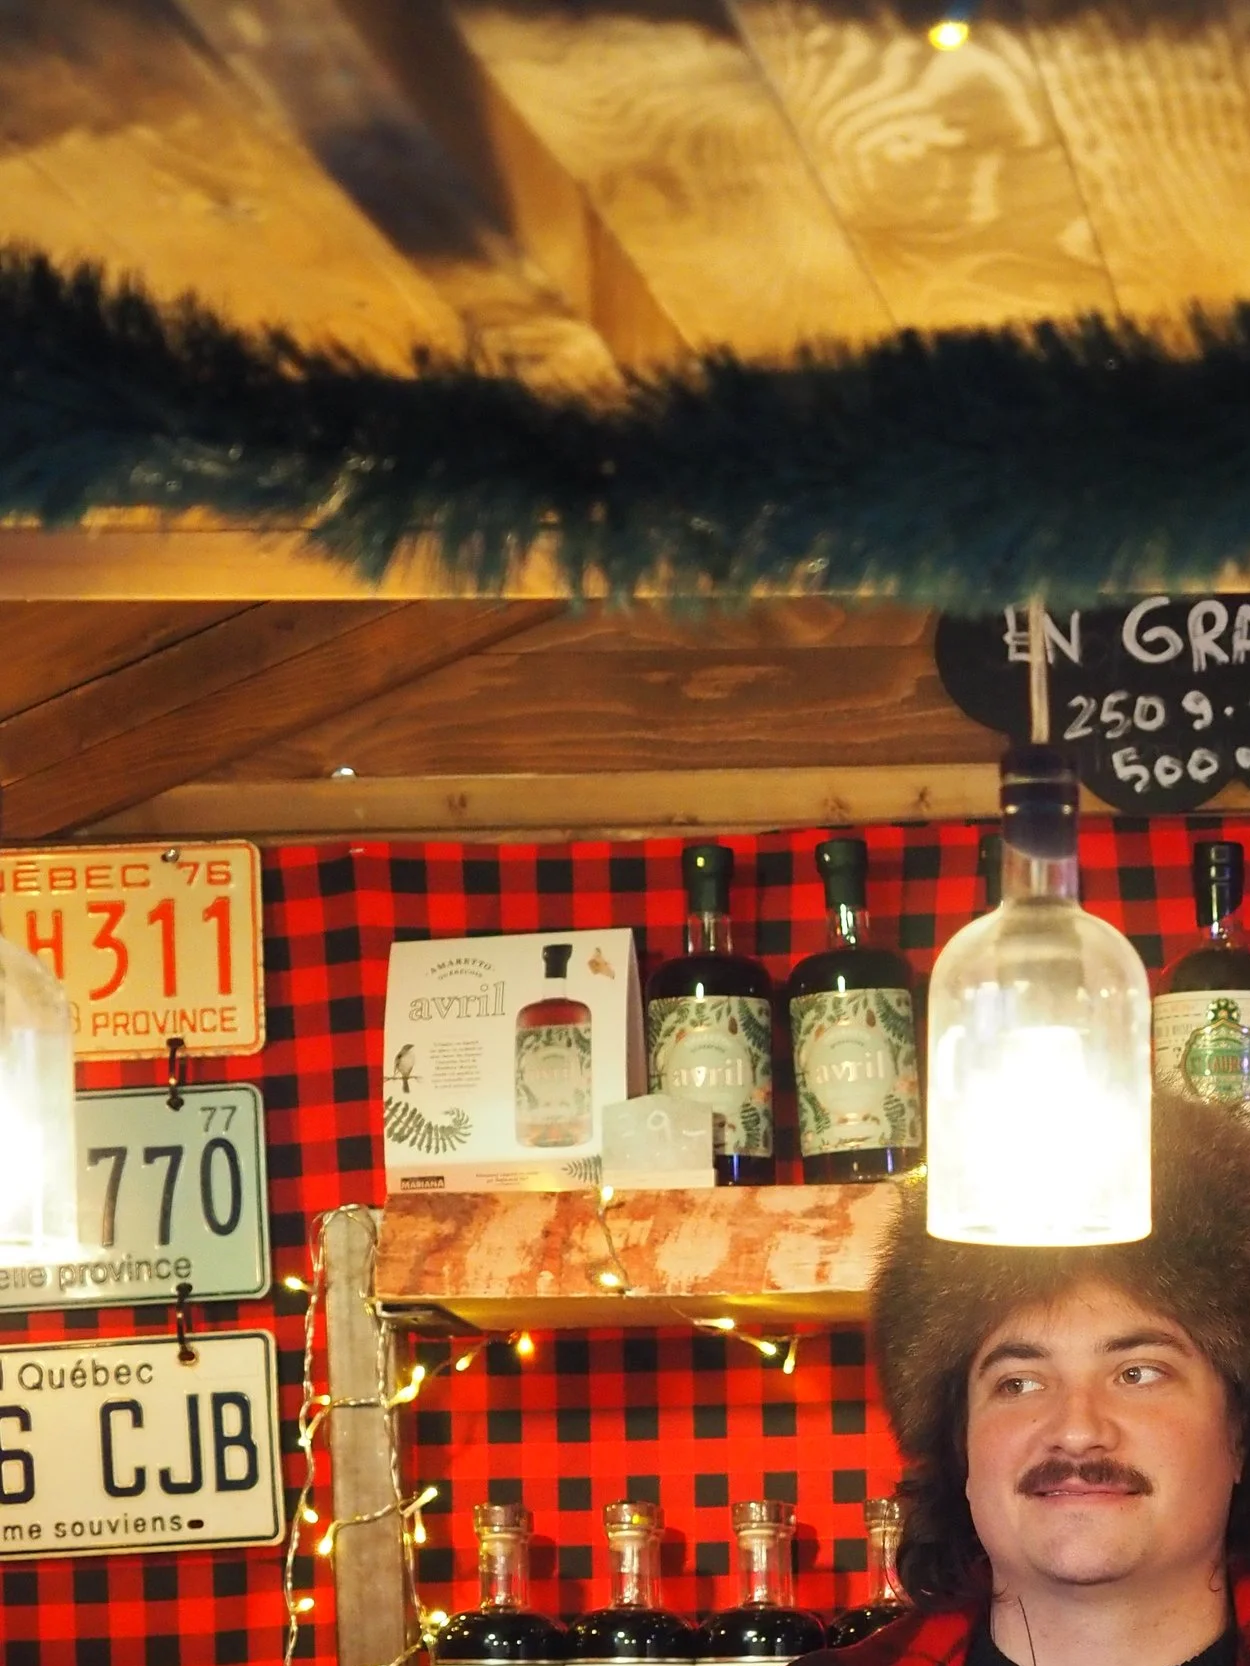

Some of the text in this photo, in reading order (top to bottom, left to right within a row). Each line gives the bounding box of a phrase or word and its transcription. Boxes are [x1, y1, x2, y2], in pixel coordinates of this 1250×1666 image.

[0, 861, 151, 893] ÉBEC
[430, 957, 492, 975] AMARETTO
[408, 980, 506, 1021] avril
[91, 1005, 239, 1038] PROVINCE
[672, 1057, 745, 1087] avril
[814, 1050, 886, 1085] avril
[199, 1105, 238, 1133] 77
[87, 1137, 243, 1248] 770
[57, 1253, 193, 1292] province
[17, 1358, 154, 1392] Québec
[99, 1390, 260, 1498] CJB
[3, 1512, 183, 1542] me souviens
